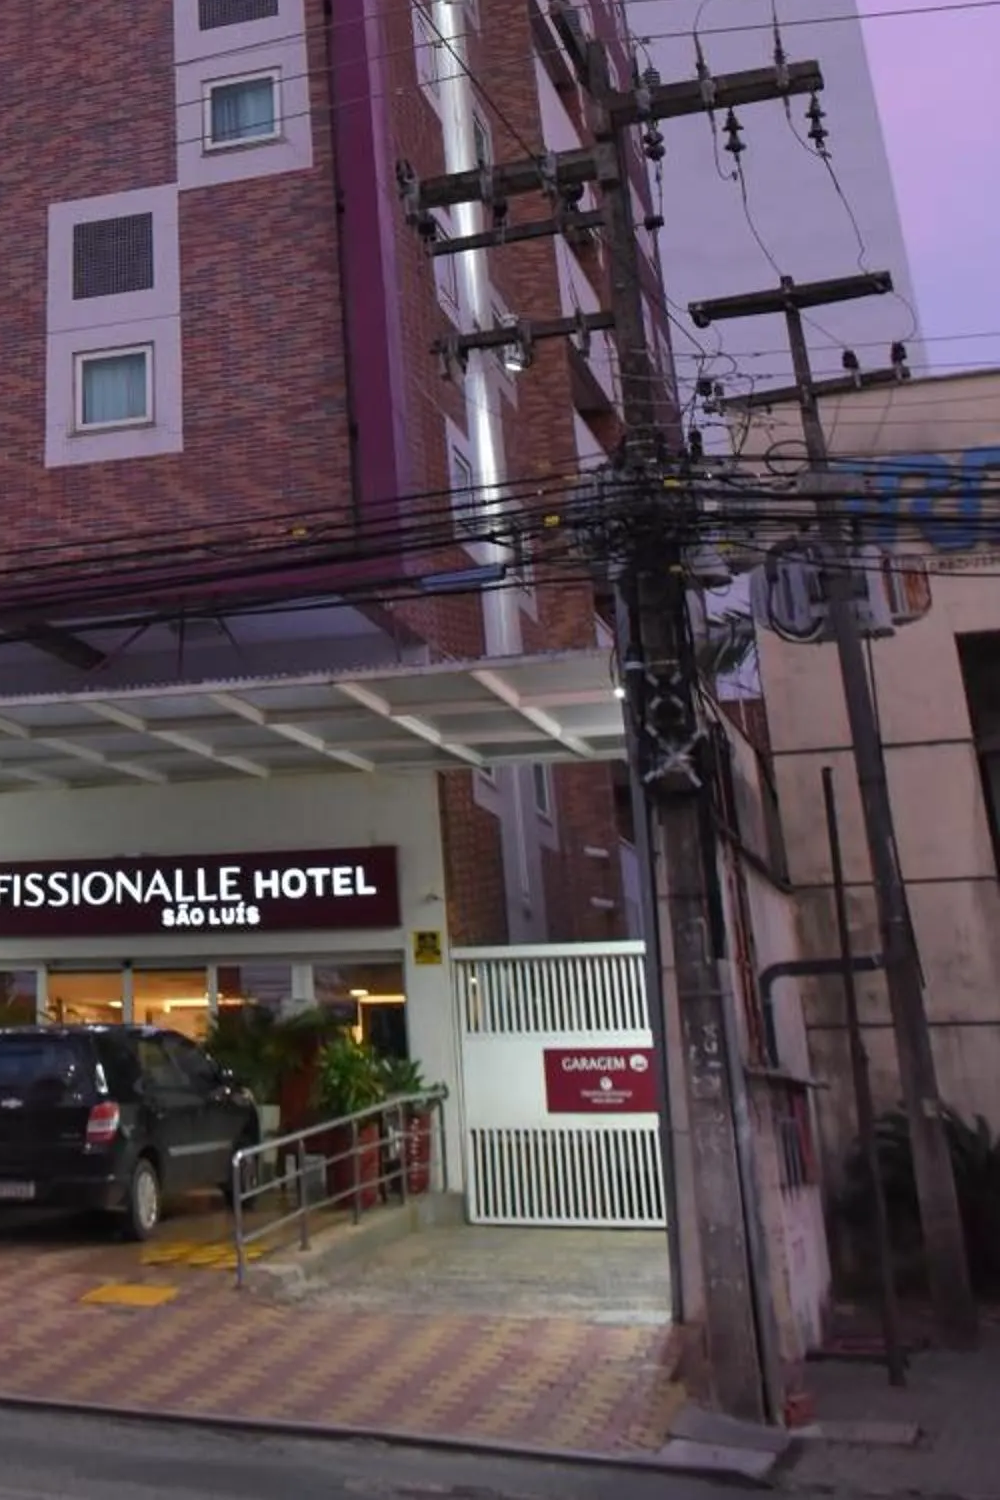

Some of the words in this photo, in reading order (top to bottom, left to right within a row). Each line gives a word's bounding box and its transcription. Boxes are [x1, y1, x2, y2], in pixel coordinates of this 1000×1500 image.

[253, 865, 378, 900] HOTEL
[161, 903, 206, 927] SÃO
[207, 901, 261, 926] LUÍS
[561, 1055, 627, 1072] GARAGEM
